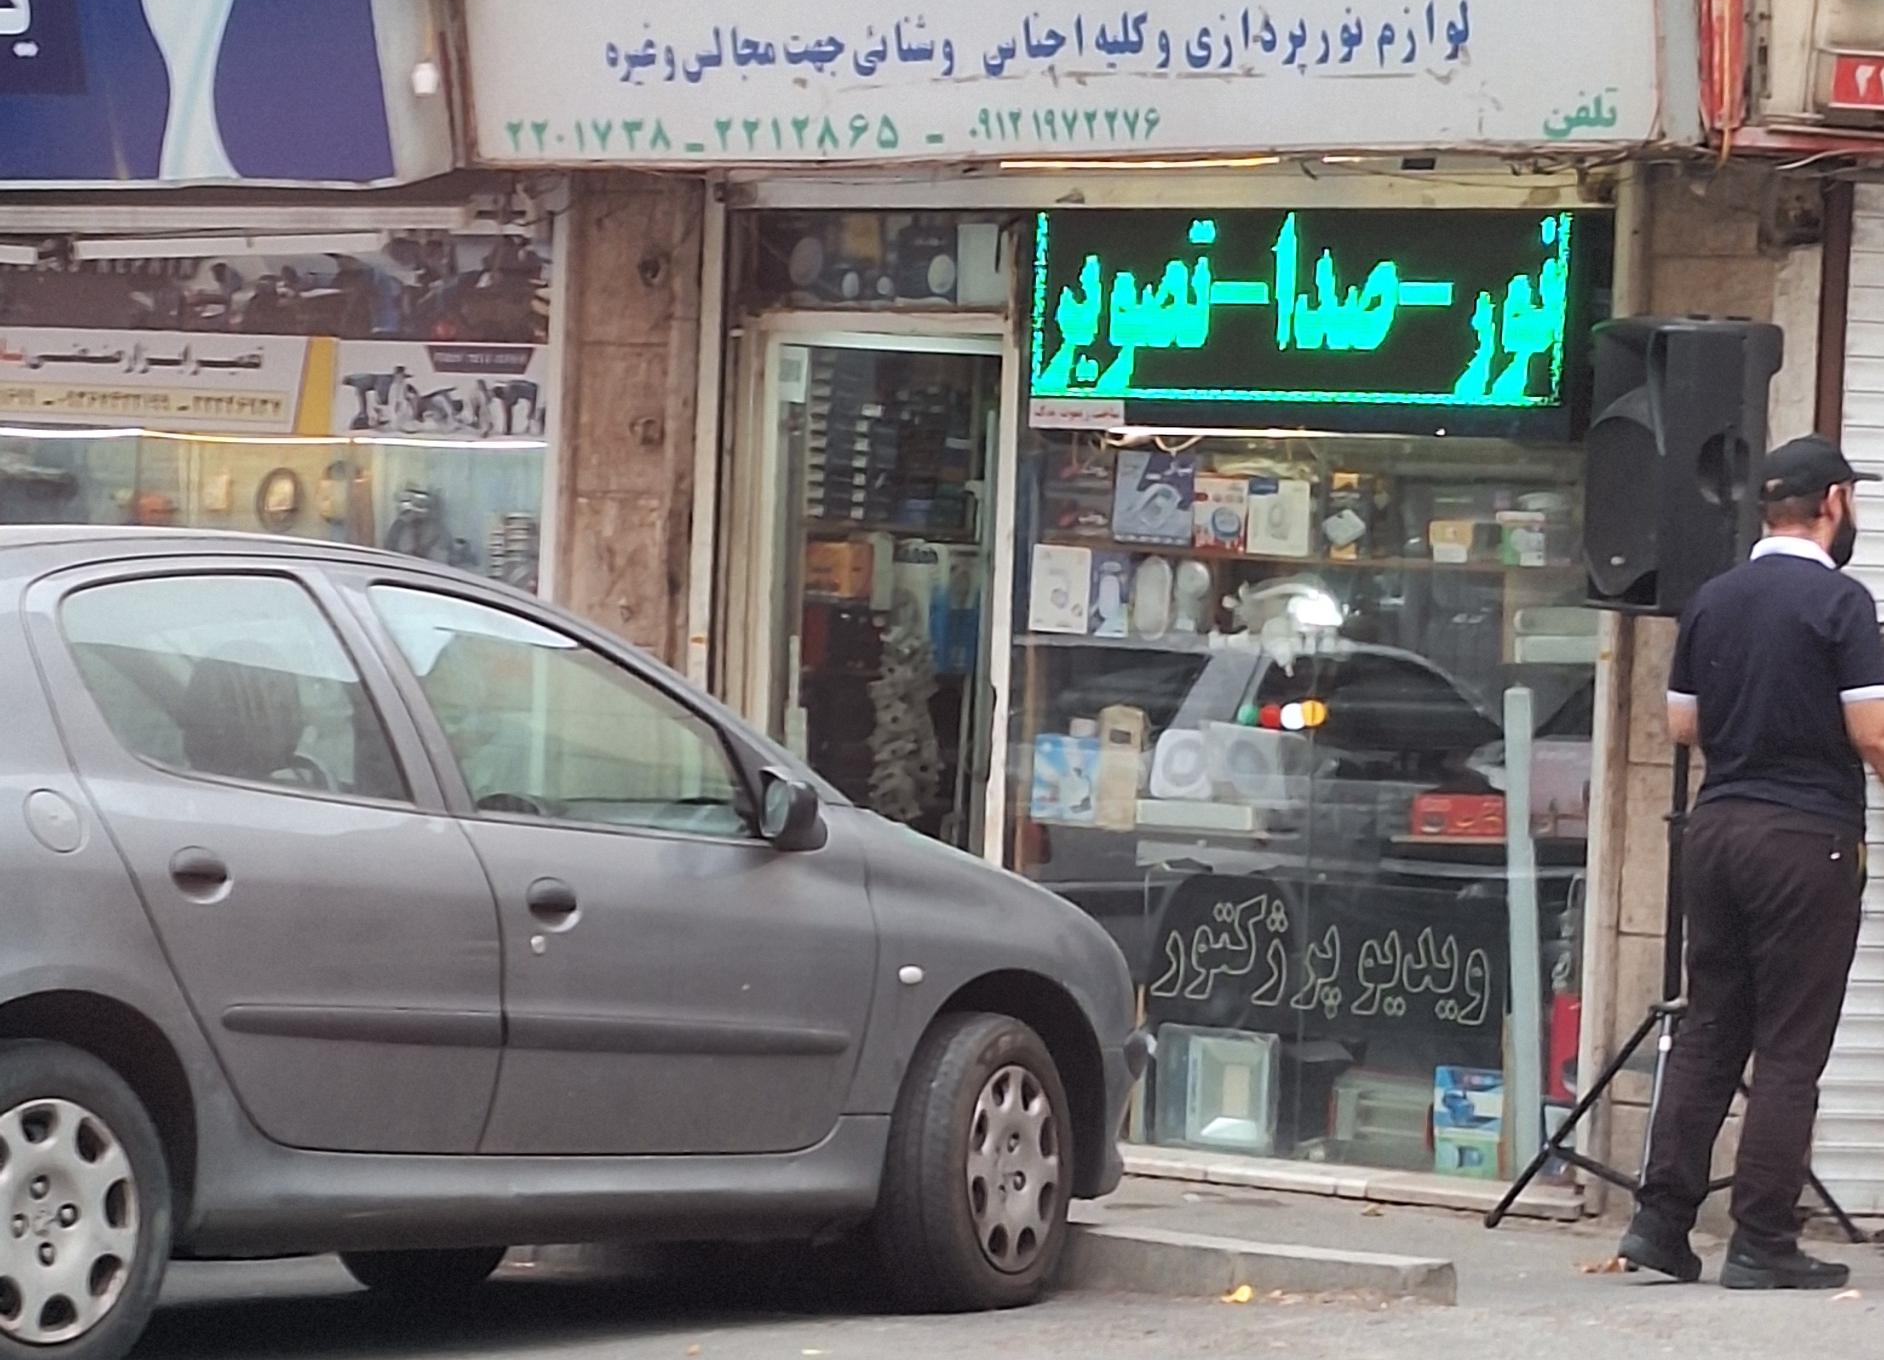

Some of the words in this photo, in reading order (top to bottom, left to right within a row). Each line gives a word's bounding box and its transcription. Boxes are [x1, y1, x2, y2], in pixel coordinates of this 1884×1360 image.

[682, 25, 776, 83] مجالس
[1094, 11, 1148, 69] کلیه
[714, 113, 899, 152] ۲۲۱۲۸۶۵
[1542, 86, 1619, 138] تلفن
[1351, 925, 1490, 1026] ویدیو
